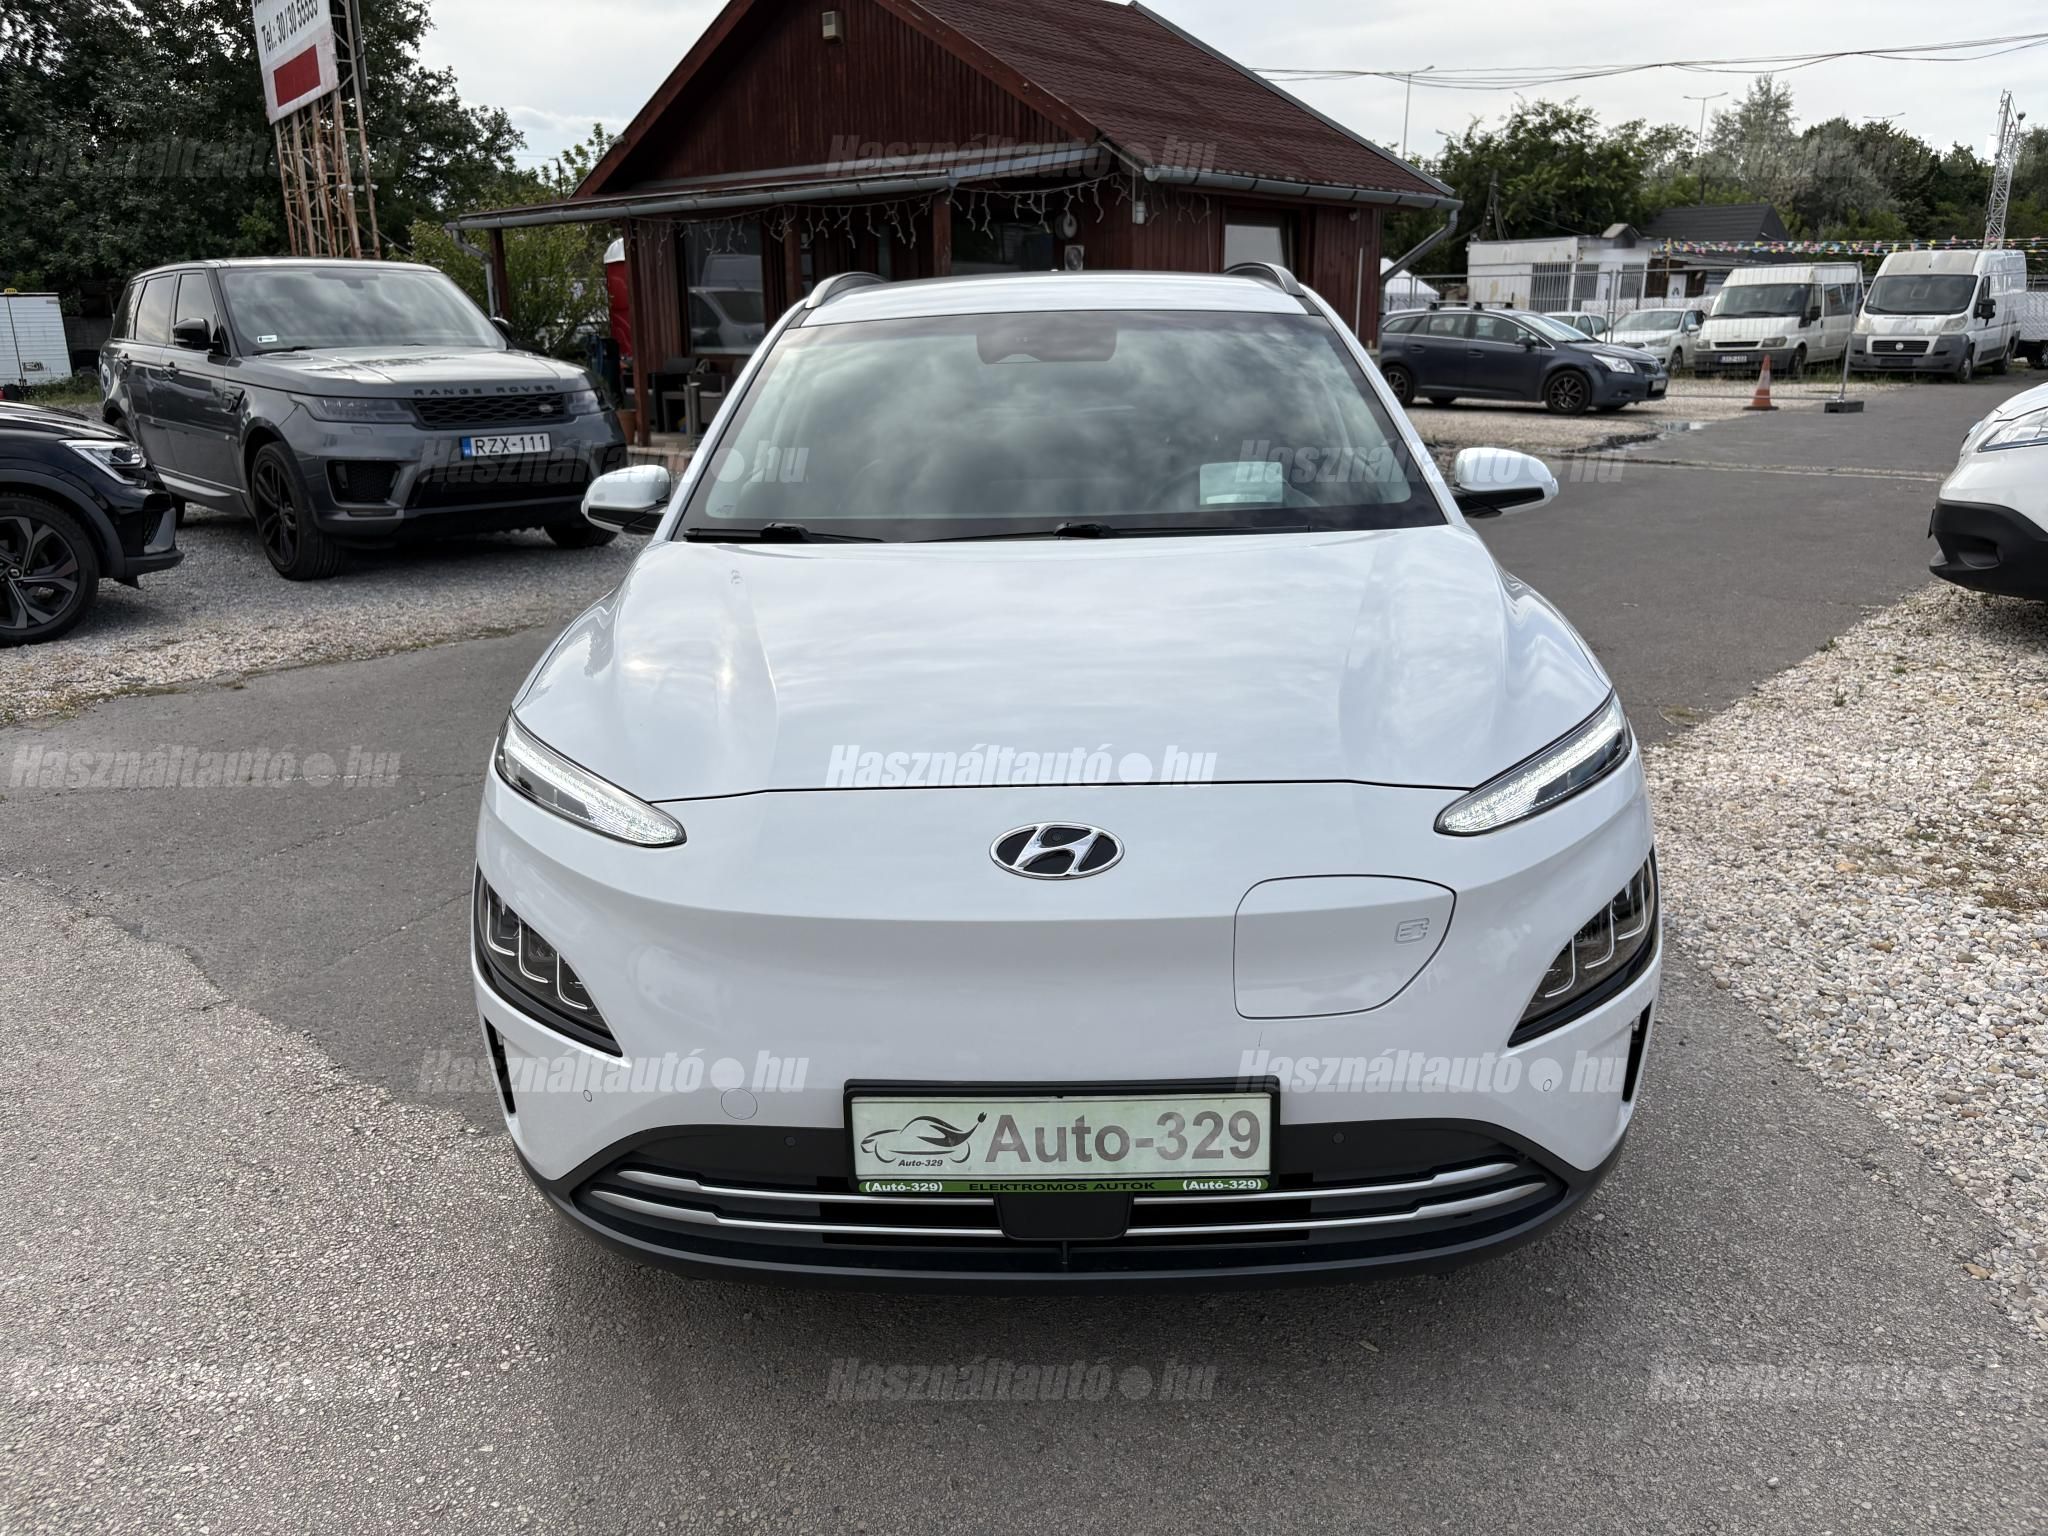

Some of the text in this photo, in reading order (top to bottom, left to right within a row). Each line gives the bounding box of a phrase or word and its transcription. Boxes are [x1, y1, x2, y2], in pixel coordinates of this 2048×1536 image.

[413, 384, 557, 396] RANGE ROVER
[474, 435, 546, 455] RZX-111
[984, 1109, 1261, 1163] Auto-329
[898, 1158, 943, 1167] Auto-329
[865, 1180, 943, 1192] (Autó-329)
[969, 1182, 1088, 1191] ELEKTROMOS
[1182, 1178, 1262, 1191] (Autó-329)
